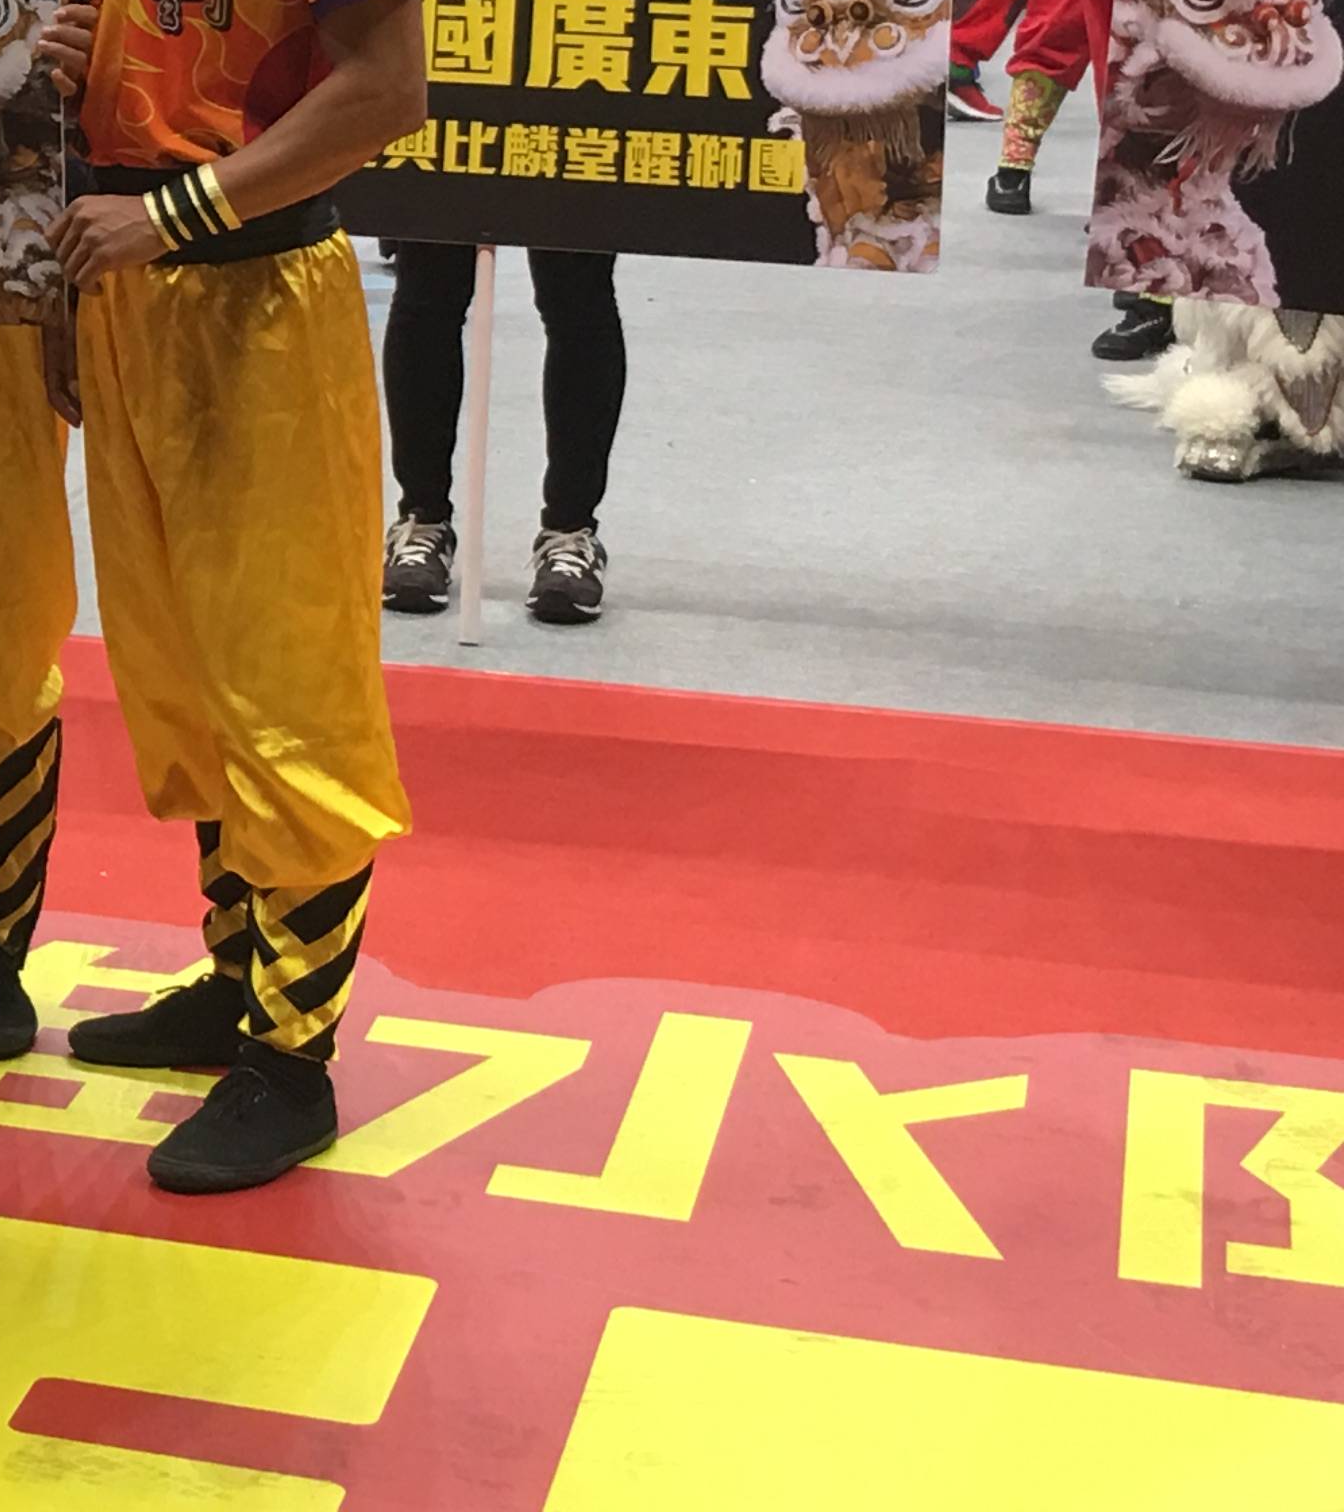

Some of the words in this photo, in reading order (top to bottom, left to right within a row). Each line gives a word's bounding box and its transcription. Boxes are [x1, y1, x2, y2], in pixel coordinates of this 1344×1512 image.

[364, 117, 806, 195] 興比麟堂醒獅團
